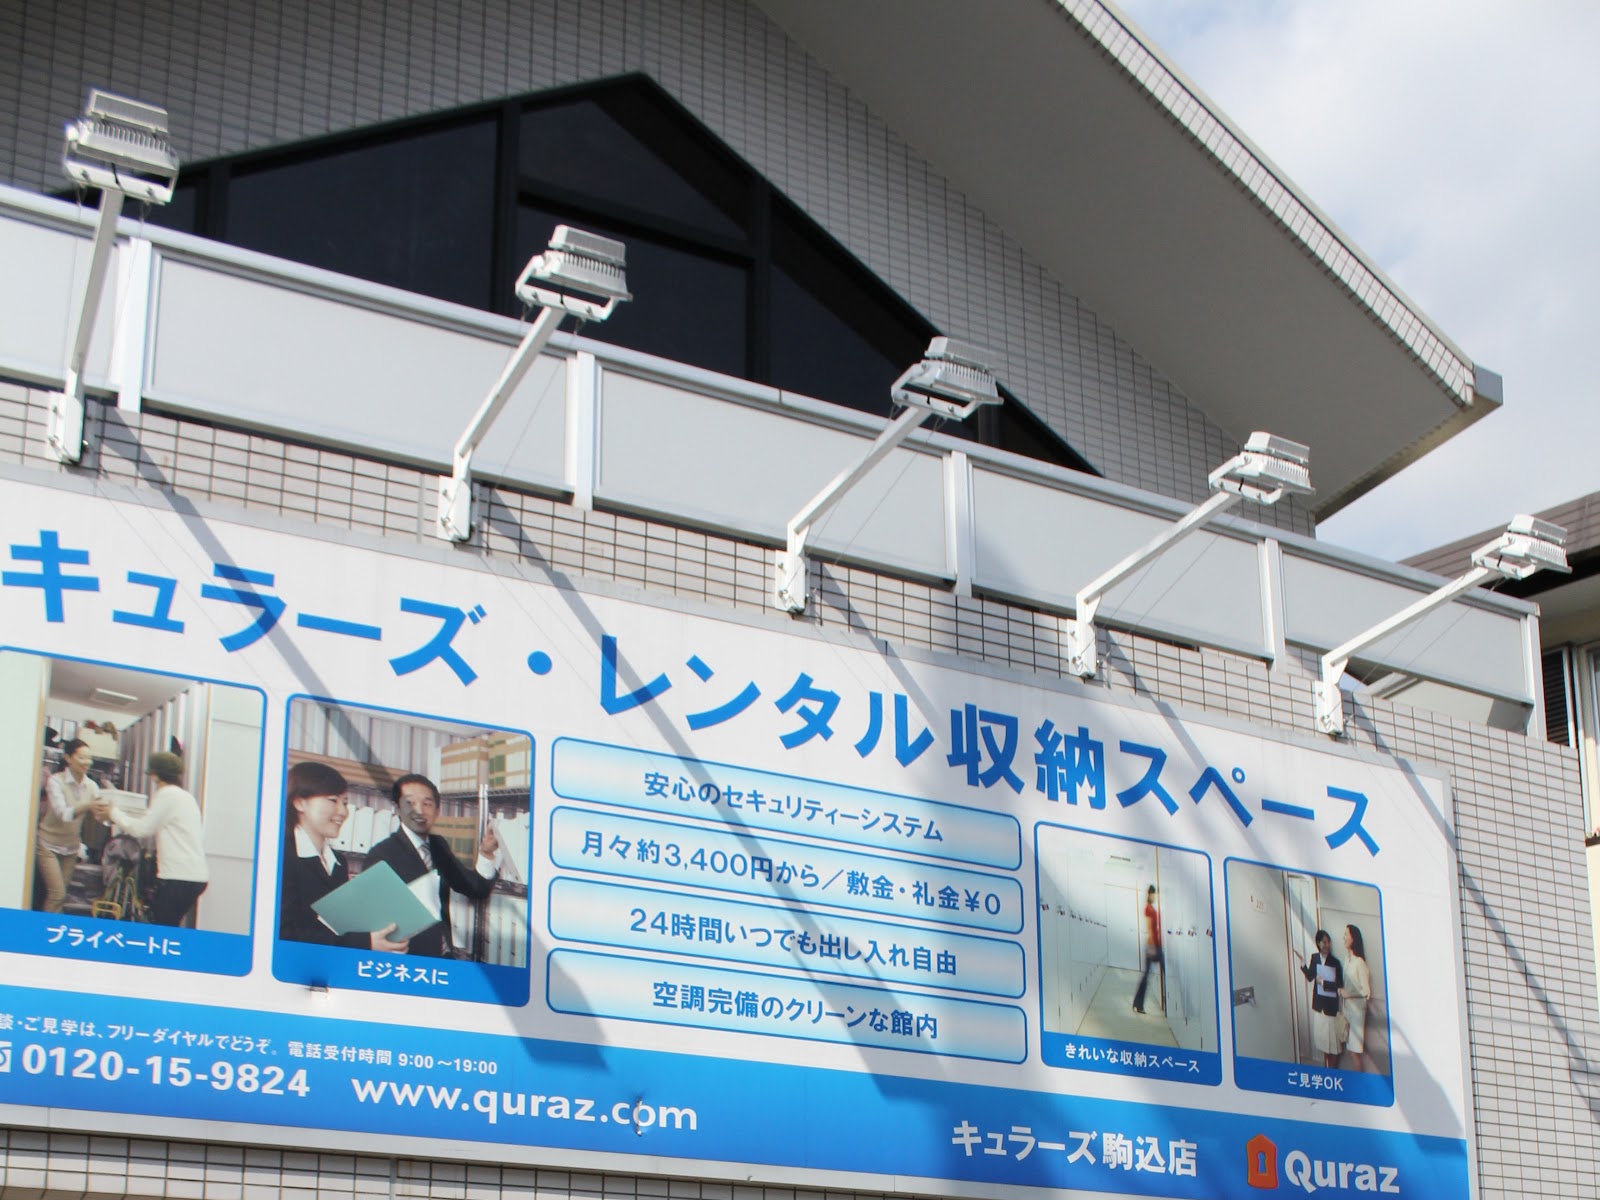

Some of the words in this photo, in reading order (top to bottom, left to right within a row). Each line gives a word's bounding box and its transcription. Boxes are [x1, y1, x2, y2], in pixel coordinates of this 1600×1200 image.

[644, 772, 943, 842] 安心のセキュリティーシステム
[47, 925, 181, 957] プライベートに
[630, 907, 957, 975] 24時間いつでも出し入れ自由
[357, 960, 449, 985] ビジネスに
[652, 981, 938, 1039] 空調完備のクリーンな館内
[287, 1041, 392, 1066] 電話受付時間
[1064, 1043, 1200, 1073] きれいな収納スペース
[22, 1043, 310, 1097] 0120-15-9824
[351, 1078, 698, 1131] www.quraz.com
[1287, 1071, 1344, 1091] ご見学OK
[1285, 1150, 1400, 1194] Quraz
